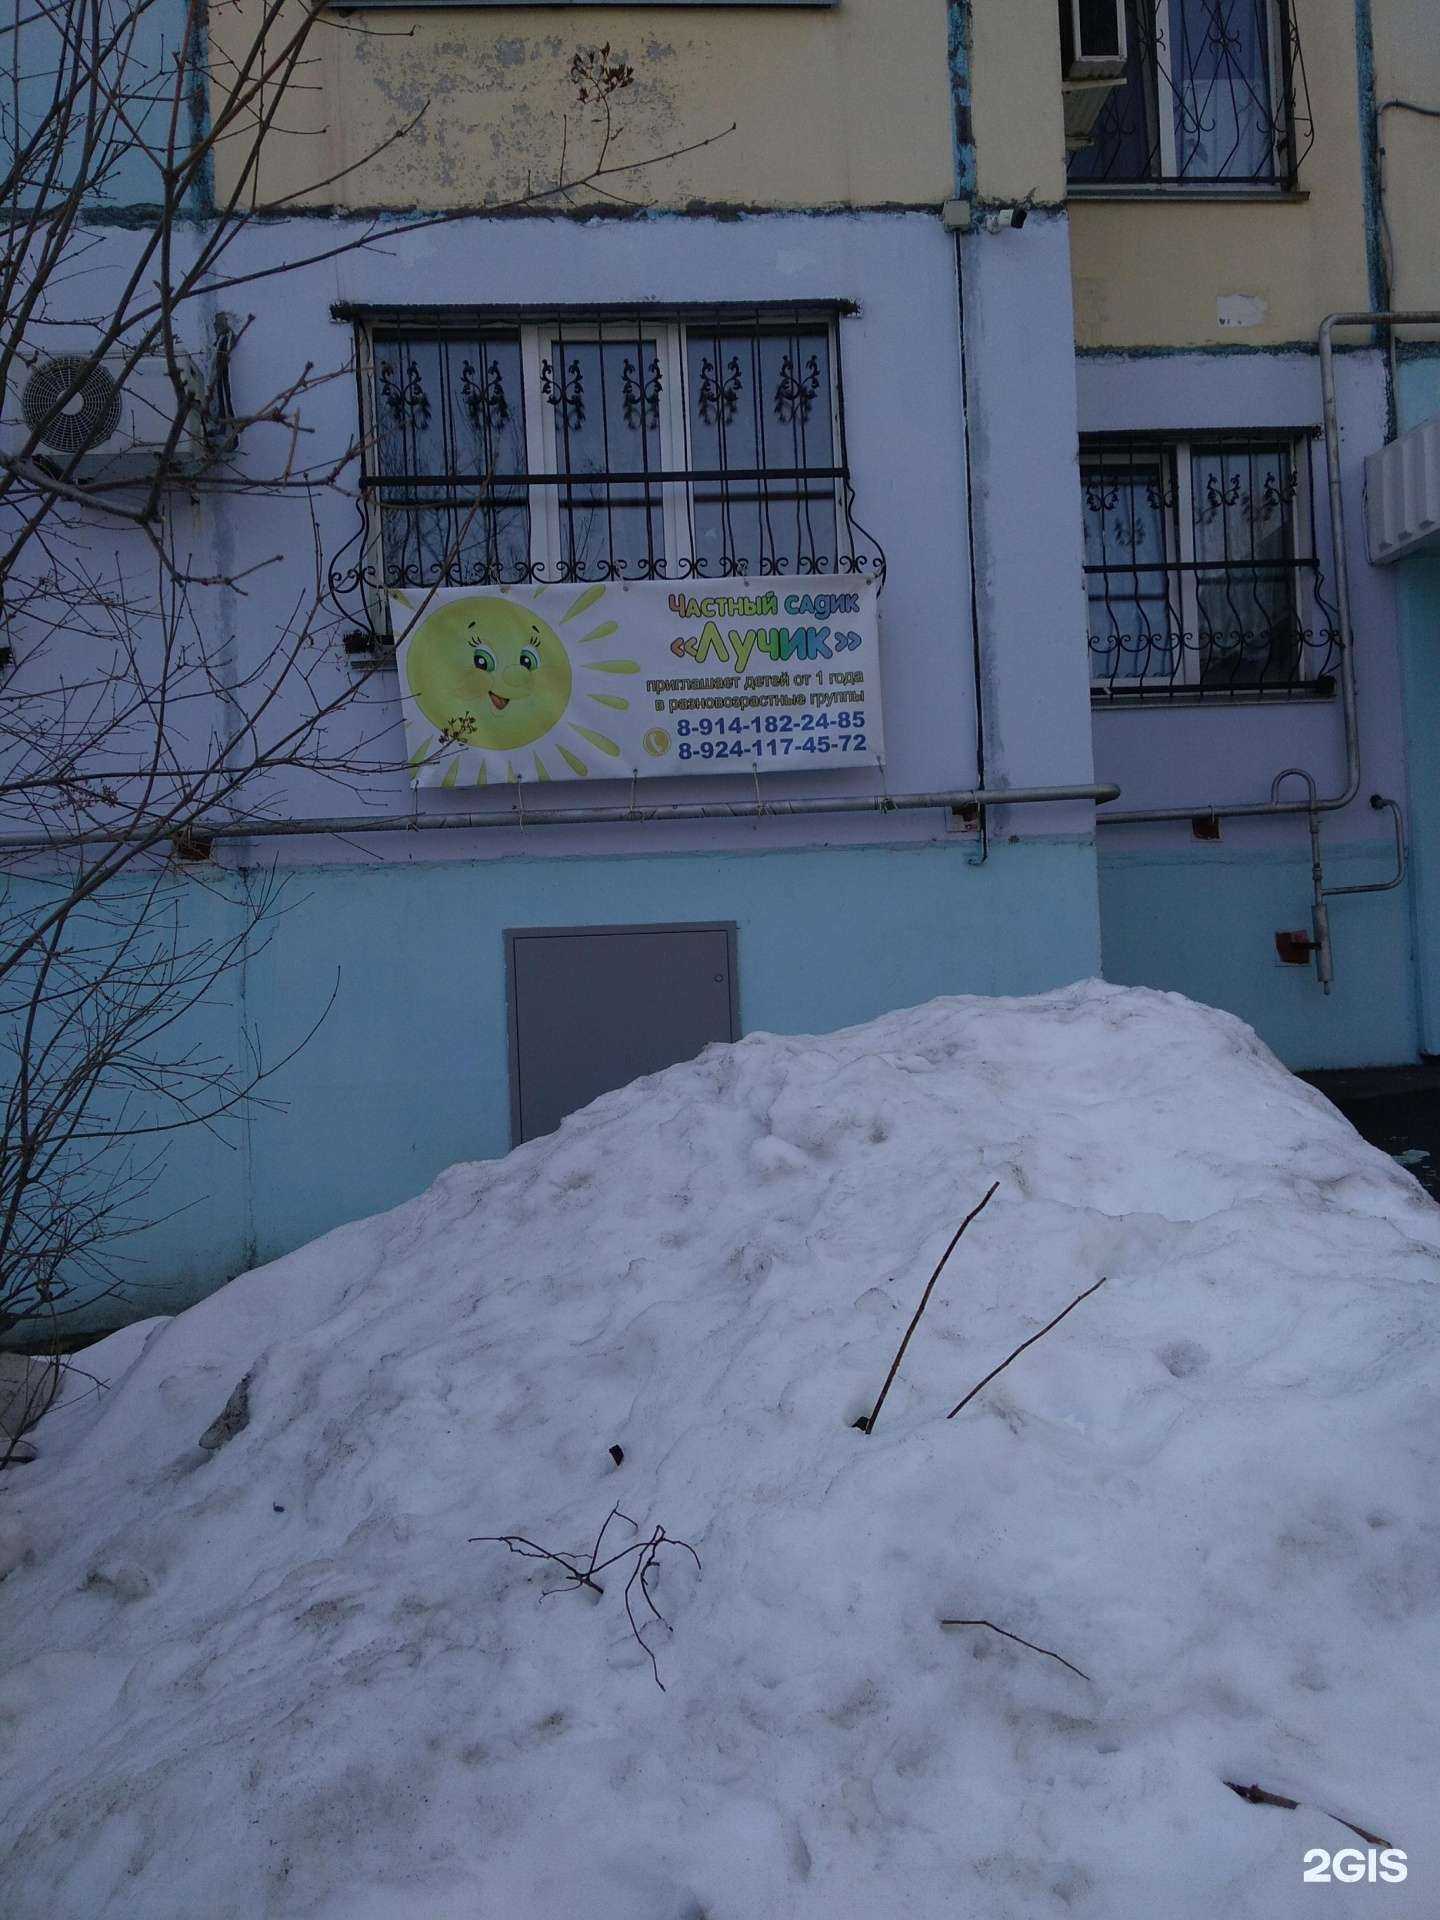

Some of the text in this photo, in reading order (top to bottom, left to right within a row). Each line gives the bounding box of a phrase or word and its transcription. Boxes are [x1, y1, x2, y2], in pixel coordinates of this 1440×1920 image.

[646, 669, 864, 694] приглашает детей от 1 года
[655, 690, 865, 713] в разновозрастные группы
[677, 711, 865, 737] 8-914-182-24-85
[678, 734, 867, 760] 8-924-117-45-72
